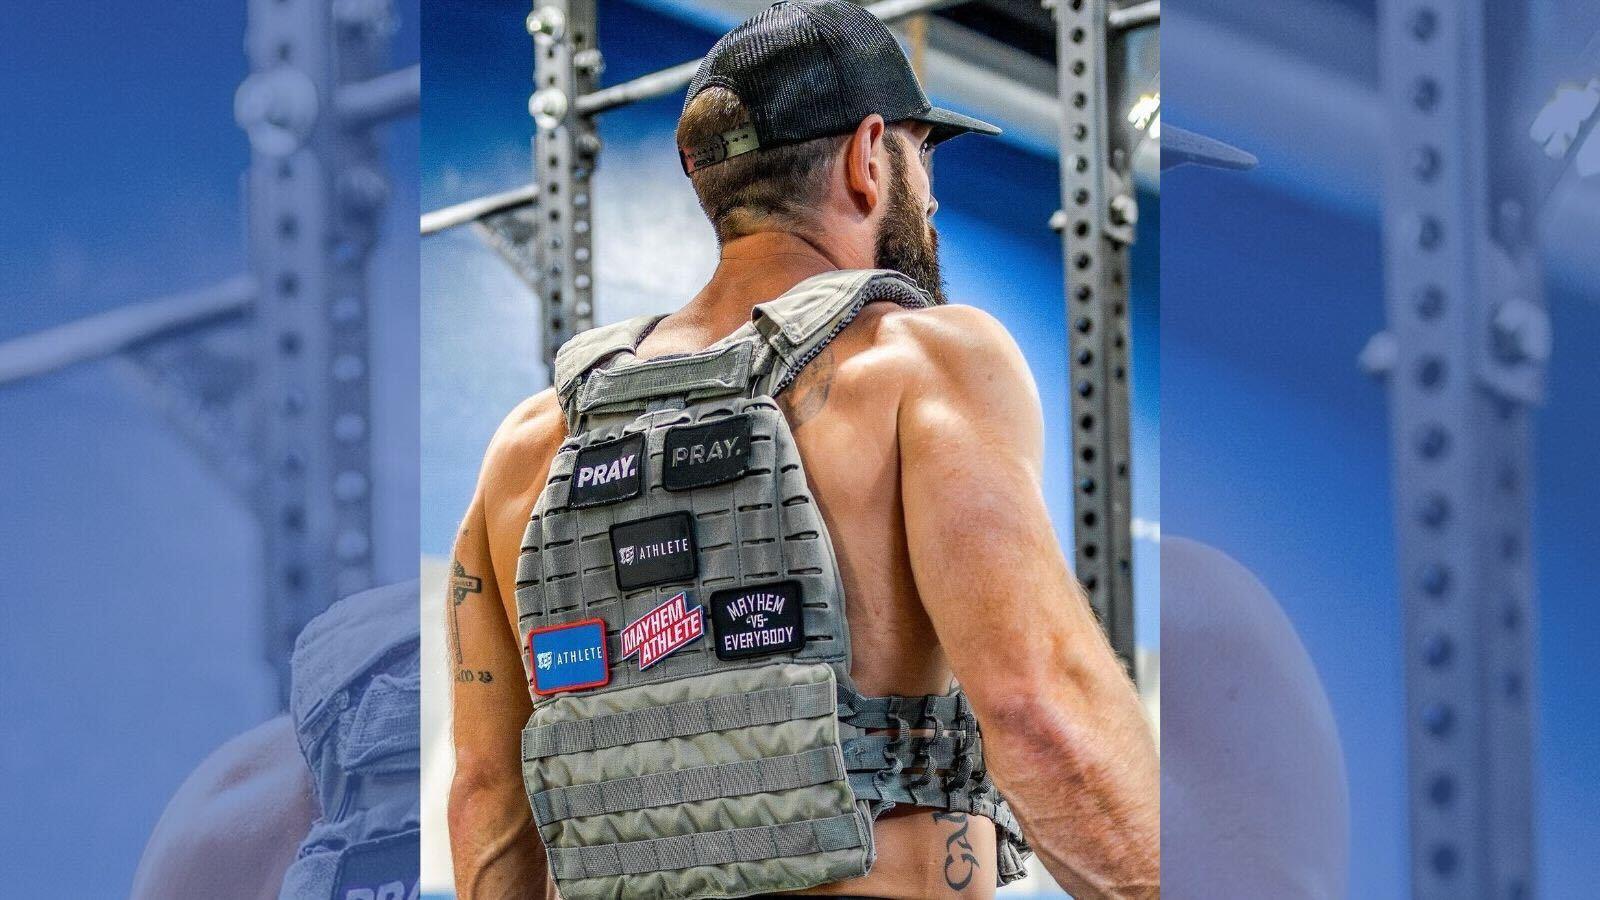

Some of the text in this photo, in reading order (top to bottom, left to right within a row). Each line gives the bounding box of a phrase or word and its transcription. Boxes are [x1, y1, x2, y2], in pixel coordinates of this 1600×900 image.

[671, 436, 741, 468] PRAY.
[577, 454, 636, 488] PRAY.
[639, 538, 689, 560] ATHLETE
[726, 593, 786, 621] MAYHEM
[624, 598, 684, 654] MAYHEM
[642, 612, 700, 664] ATHLETE
[724, 626, 794, 651] EVERYBODY
[557, 646, 603, 665] ATHLETE
